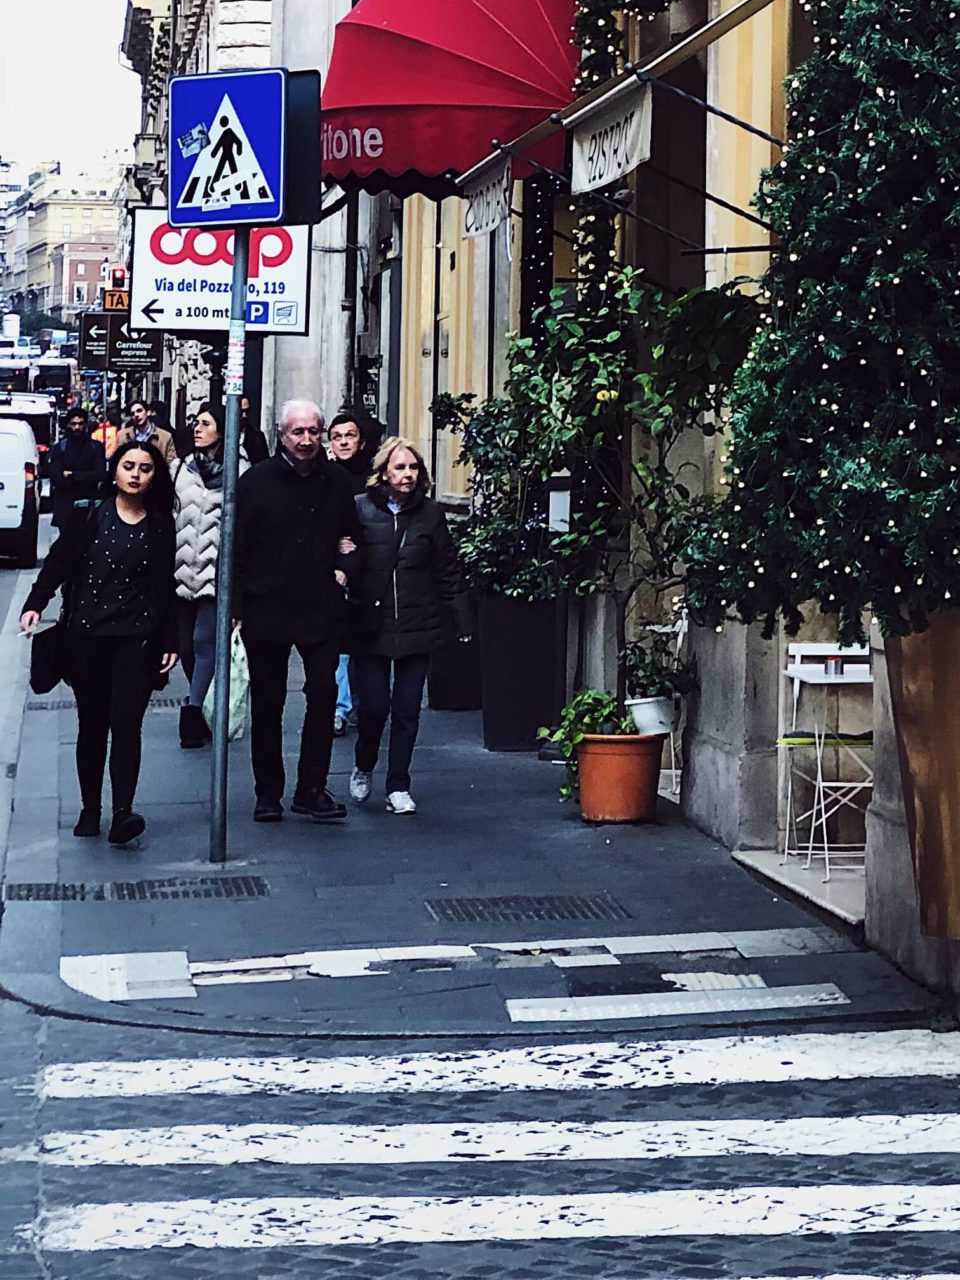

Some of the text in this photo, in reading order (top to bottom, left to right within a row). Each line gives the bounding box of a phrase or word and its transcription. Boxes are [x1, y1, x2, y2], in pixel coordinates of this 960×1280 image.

[320, 122, 384, 161] itone
[155, 278, 285, 296] Via del Pozzo, 119
[108, 293, 129, 308] TA
[175, 307, 229, 318] a 100 mt
[115, 340, 153, 349] Carrefour
